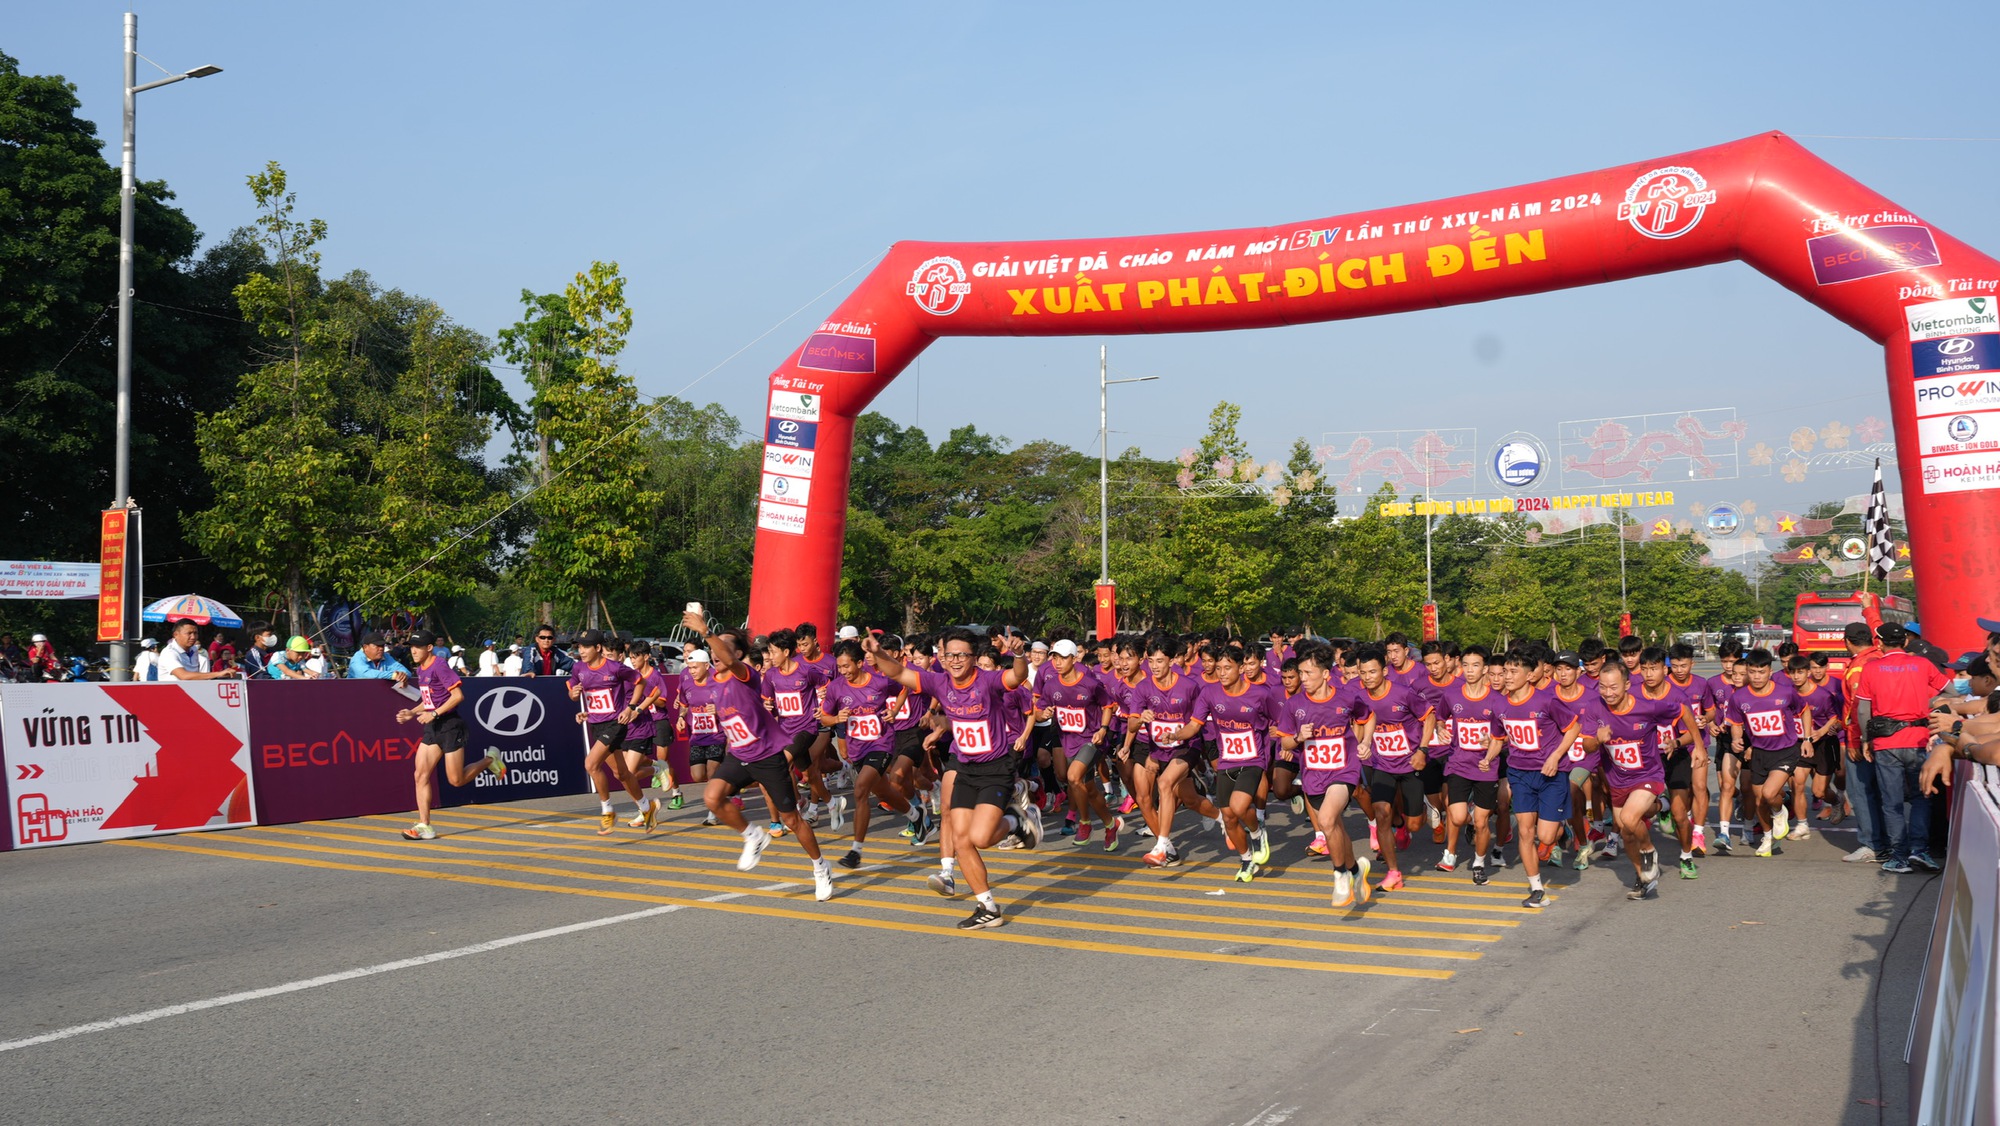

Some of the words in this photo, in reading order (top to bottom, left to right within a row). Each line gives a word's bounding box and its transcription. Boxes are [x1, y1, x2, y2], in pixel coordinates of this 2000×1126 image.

[1686, 192, 1714, 206] 2024
[1618, 202, 1650, 219] BTV
[1844, 213, 1870, 228] trợ
[1874, 211, 1918, 224] chính
[972, 256, 1019, 278] GIẢI
[1023, 254, 1074, 279] VIỆT
[1078, 251, 1108, 272] DÃ
[1119, 248, 1173, 268] CHÀO
[1186, 244, 1236, 262] NĂM
[1244, 235, 1288, 256] MỚI
[1288, 227, 1342, 250] BTV
[1345, 220, 1384, 242] LẦN
[1392, 216, 1434, 236] THỨ
[1550, 192, 1602, 212] 2024
[1824, 241, 1922, 268] BECEX
[1006, 272, 1126, 315] XUẤT
[1426, 224, 1546, 278] ĐẾN
[908, 282, 927, 294] BTV
[951, 284, 970, 293] 2024
[1898, 281, 1944, 300] Đồng
[1948, 278, 1973, 292] Tài
[1976, 279, 1998, 292] trợ
[841, 321, 872, 335] chính
[1911, 313, 1996, 332] Vietcombank
[808, 346, 866, 360] BECAMEX
[1941, 356, 1974, 366] Hyundai
[792, 378, 808, 388] Tài
[808, 382, 824, 392] trợ
[1918, 380, 2000, 402] PROWIN
[1976, 396, 2000, 404] MOVIN
[772, 403, 817, 416] Vietcombank
[1932, 444, 1959, 454] BIWASE
[1980, 440, 1998, 449] GOLD
[1944, 464, 1981, 478] HOÀN
[1380, 500, 1413, 517] CHÚC
[1415, 498, 1453, 516] MỪNG
[1456, 496, 1486, 514] NĂM
[1489, 496, 1515, 513] MỚI
[1517, 498, 1550, 512] 2024
[1552, 494, 1598, 510] HAPPY
[1600, 492, 1633, 508] NEW
[1636, 491, 1674, 506] YEAR
[787, 514, 805, 524] HẢO
[26, 588, 43, 596] CÁCH
[587, 694, 610, 710] 251
[694, 715, 714, 730] 255
[1059, 711, 1084, 728] 309
[1154, 711, 1184, 720] ECAMEX
[1750, 715, 1781, 733] 342
[23, 707, 92, 748] VỮNG
[101, 714, 140, 744] TIN
[726, 722, 748, 743] 78
[850, 718, 879, 737] 263
[1633, 722, 1648, 730] BTV
[956, 726, 986, 748] 261
[1375, 734, 1406, 752] 322
[1505, 725, 1534, 745] 390
[262, 730, 424, 769] BECAMEX
[483, 744, 546, 762] yundai
[1225, 736, 1252, 755] 281
[1308, 744, 1342, 764] 332
[1614, 747, 1638, 764] 43
[511, 769, 558, 785] Dương
[82, 805, 104, 816] HẢO
